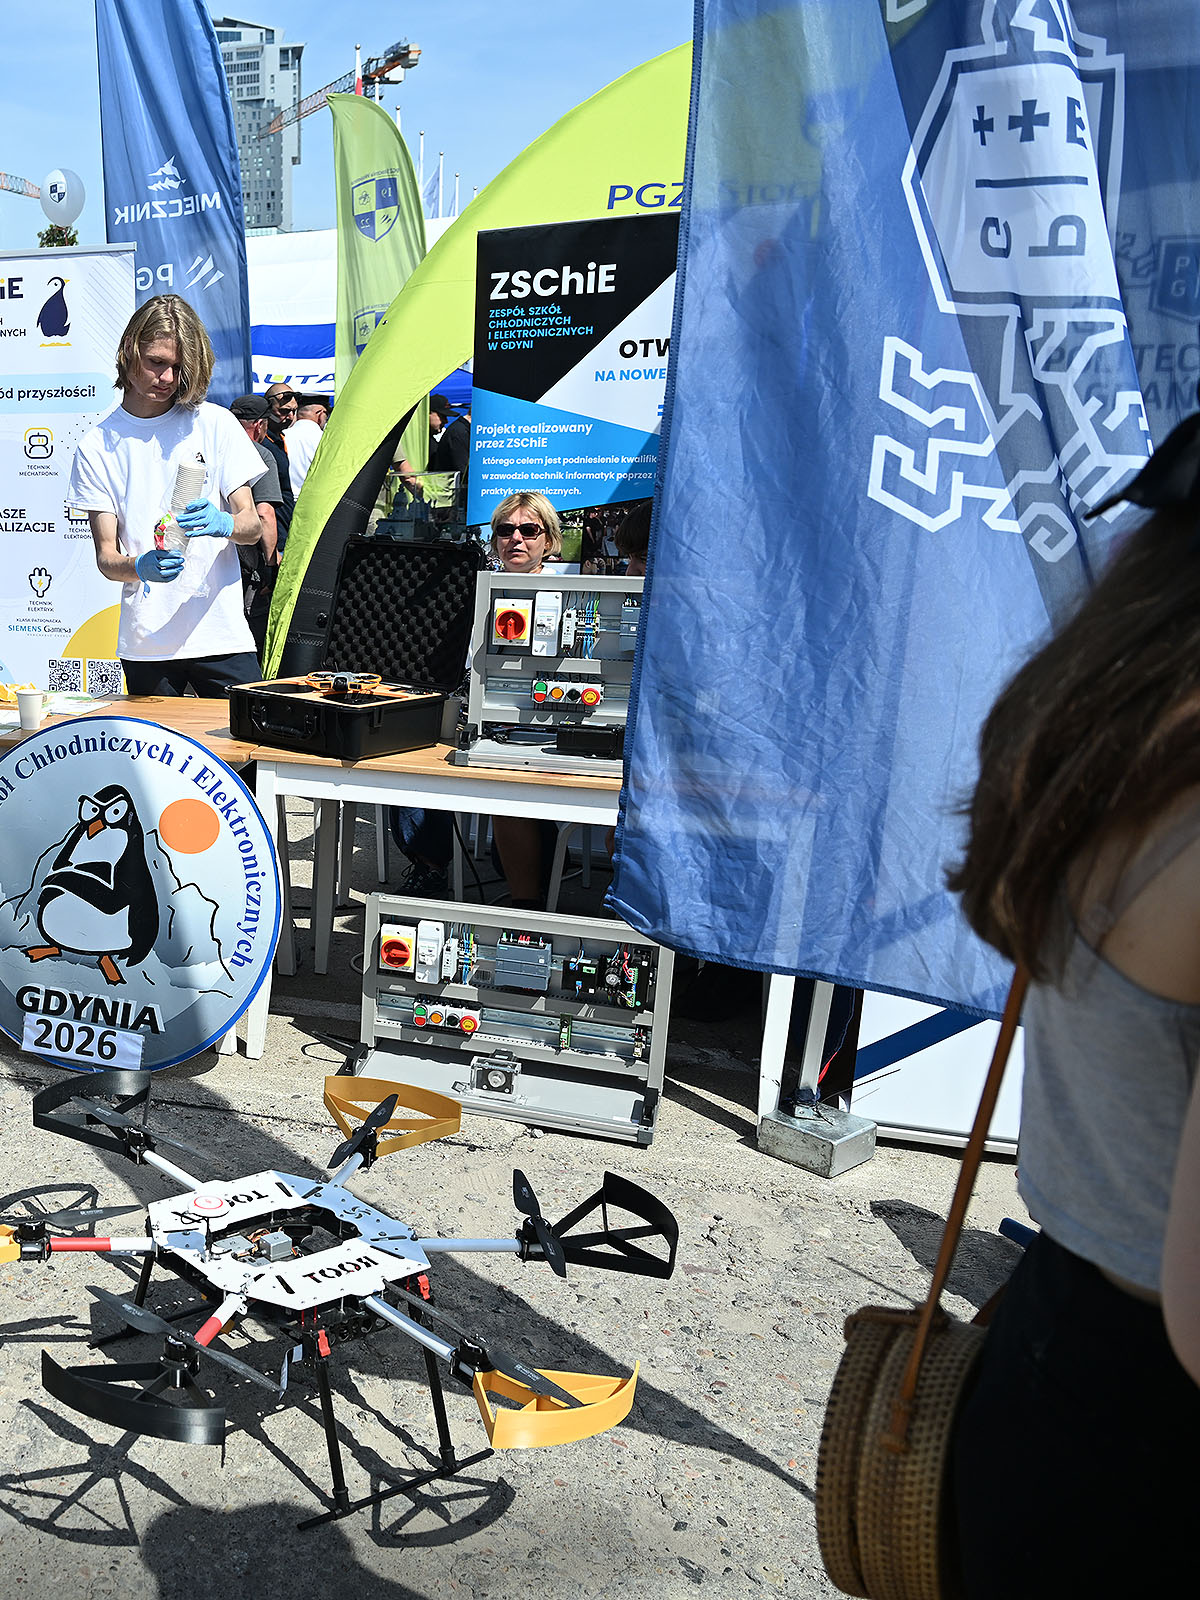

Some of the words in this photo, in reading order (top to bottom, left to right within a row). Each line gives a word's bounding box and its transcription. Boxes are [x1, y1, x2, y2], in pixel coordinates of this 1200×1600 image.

[489, 261, 617, 300] ZSChiE
[489, 306, 526, 318] ZESPÓŁ
[528, 304, 563, 316] SZKÓŁ
[488, 316, 571, 329] CHŁODNICZYCH
[494, 326, 594, 340] ELEKTRONICZNYCH
[488, 342, 498, 351] W
[500, 340, 534, 350] GDYNI
[594, 370, 616, 382] NA
[17, 385, 96, 402] przyszłości!
[476, 424, 516, 437] Projekt
[517, 422, 593, 435] realizowany
[475, 439, 505, 451] przez
[506, 437, 548, 448] ZSChiE
[482, 456, 515, 466] którego
[516, 456, 544, 464] celem
[544, 456, 561, 466] jest
[562, 455, 620, 465] podniesienie
[490, 471, 529, 480] zawodzie
[530, 471, 564, 480] technik
[565, 471, 615, 481] informatyk
[616, 472, 652, 481] poprzez
[480, 487, 513, 497] praktyk
[8, 624, 42, 633] SIEMENS
[13, 730, 174, 781] Chłodniczych
[178, 754, 194, 773] i
[191, 764, 267, 968] Elektronicznych
[15, 985, 162, 1035] GDYNIA
[33, 1019, 118, 1060] 2026
